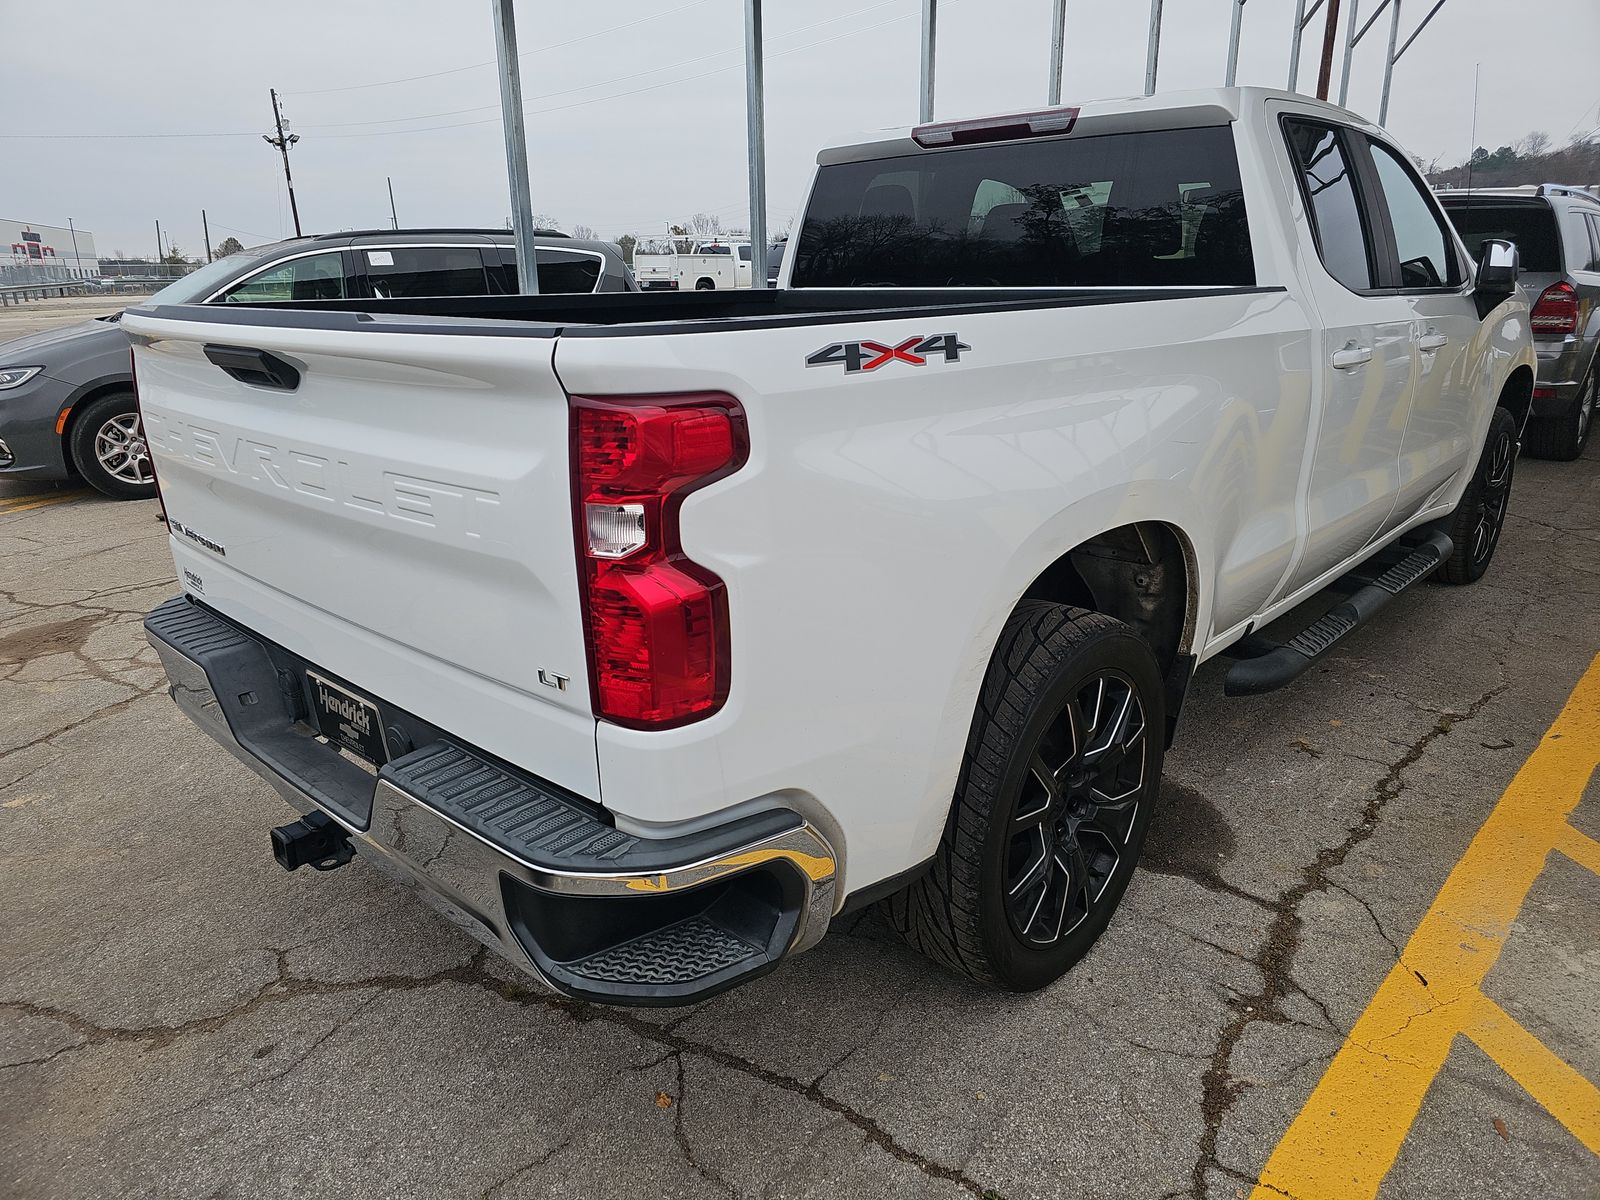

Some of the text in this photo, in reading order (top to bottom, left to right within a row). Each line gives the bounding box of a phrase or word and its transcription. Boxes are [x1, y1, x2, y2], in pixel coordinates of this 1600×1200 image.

[143, 409, 501, 540] CHEVROLET
[537, 666, 570, 691] LT
[319, 684, 371, 732] Hendrick
